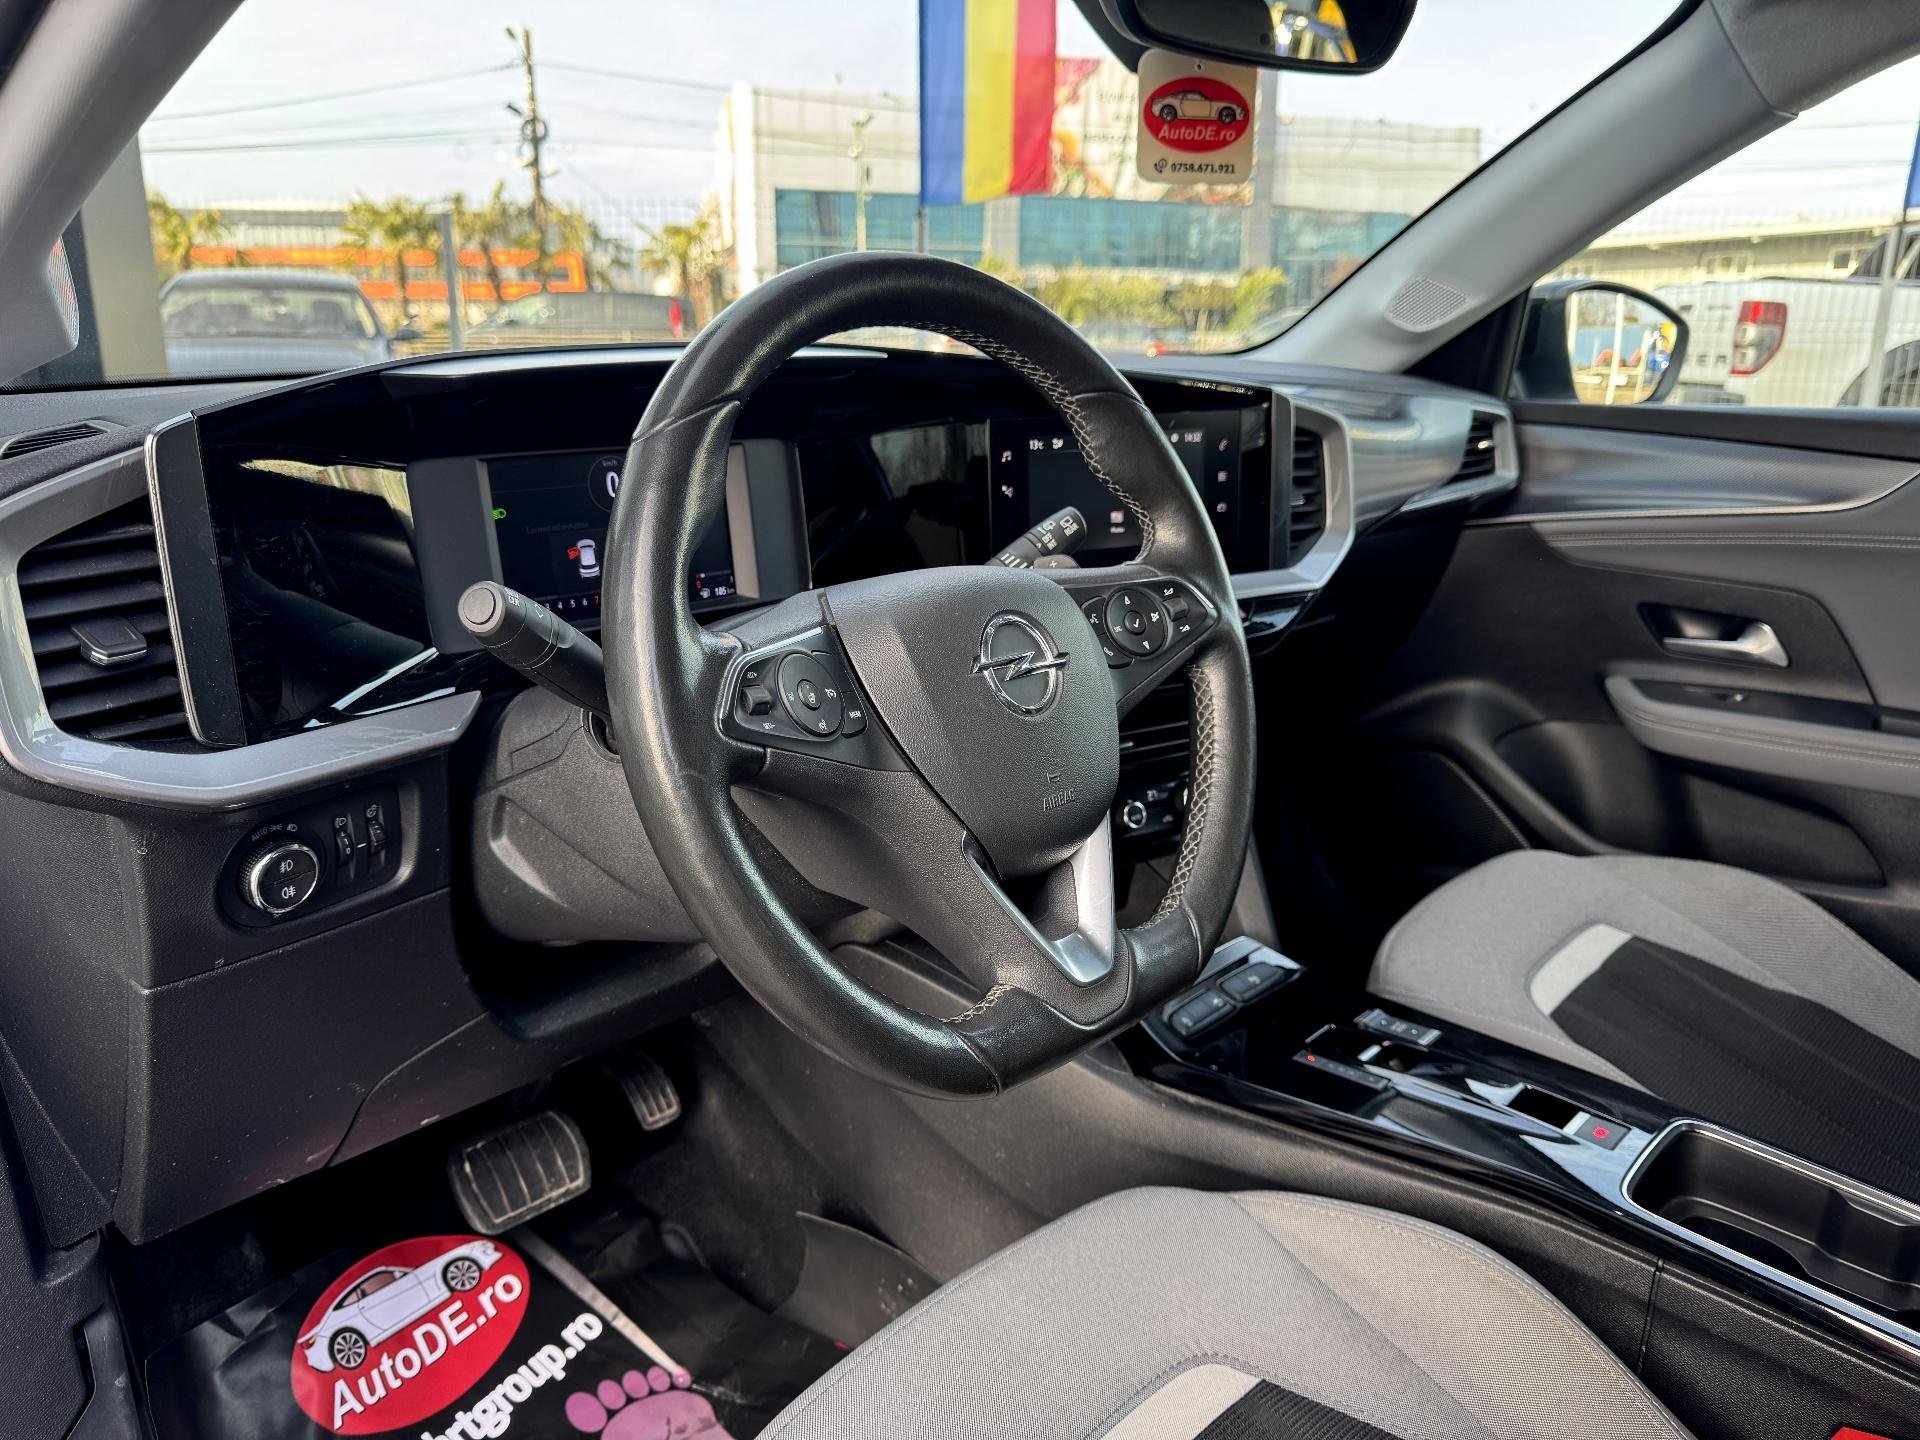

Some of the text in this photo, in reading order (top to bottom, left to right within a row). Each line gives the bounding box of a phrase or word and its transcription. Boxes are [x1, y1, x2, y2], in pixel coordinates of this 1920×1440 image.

[1158, 124, 1236, 142] AutoDE.ro
[570, 598, 576, 608] 5
[583, 597, 588, 607] 6
[594, 596, 600, 605] 7
[250, 826, 268, 841] AUTO
[333, 1272, 524, 1431] AutoDE.ro
